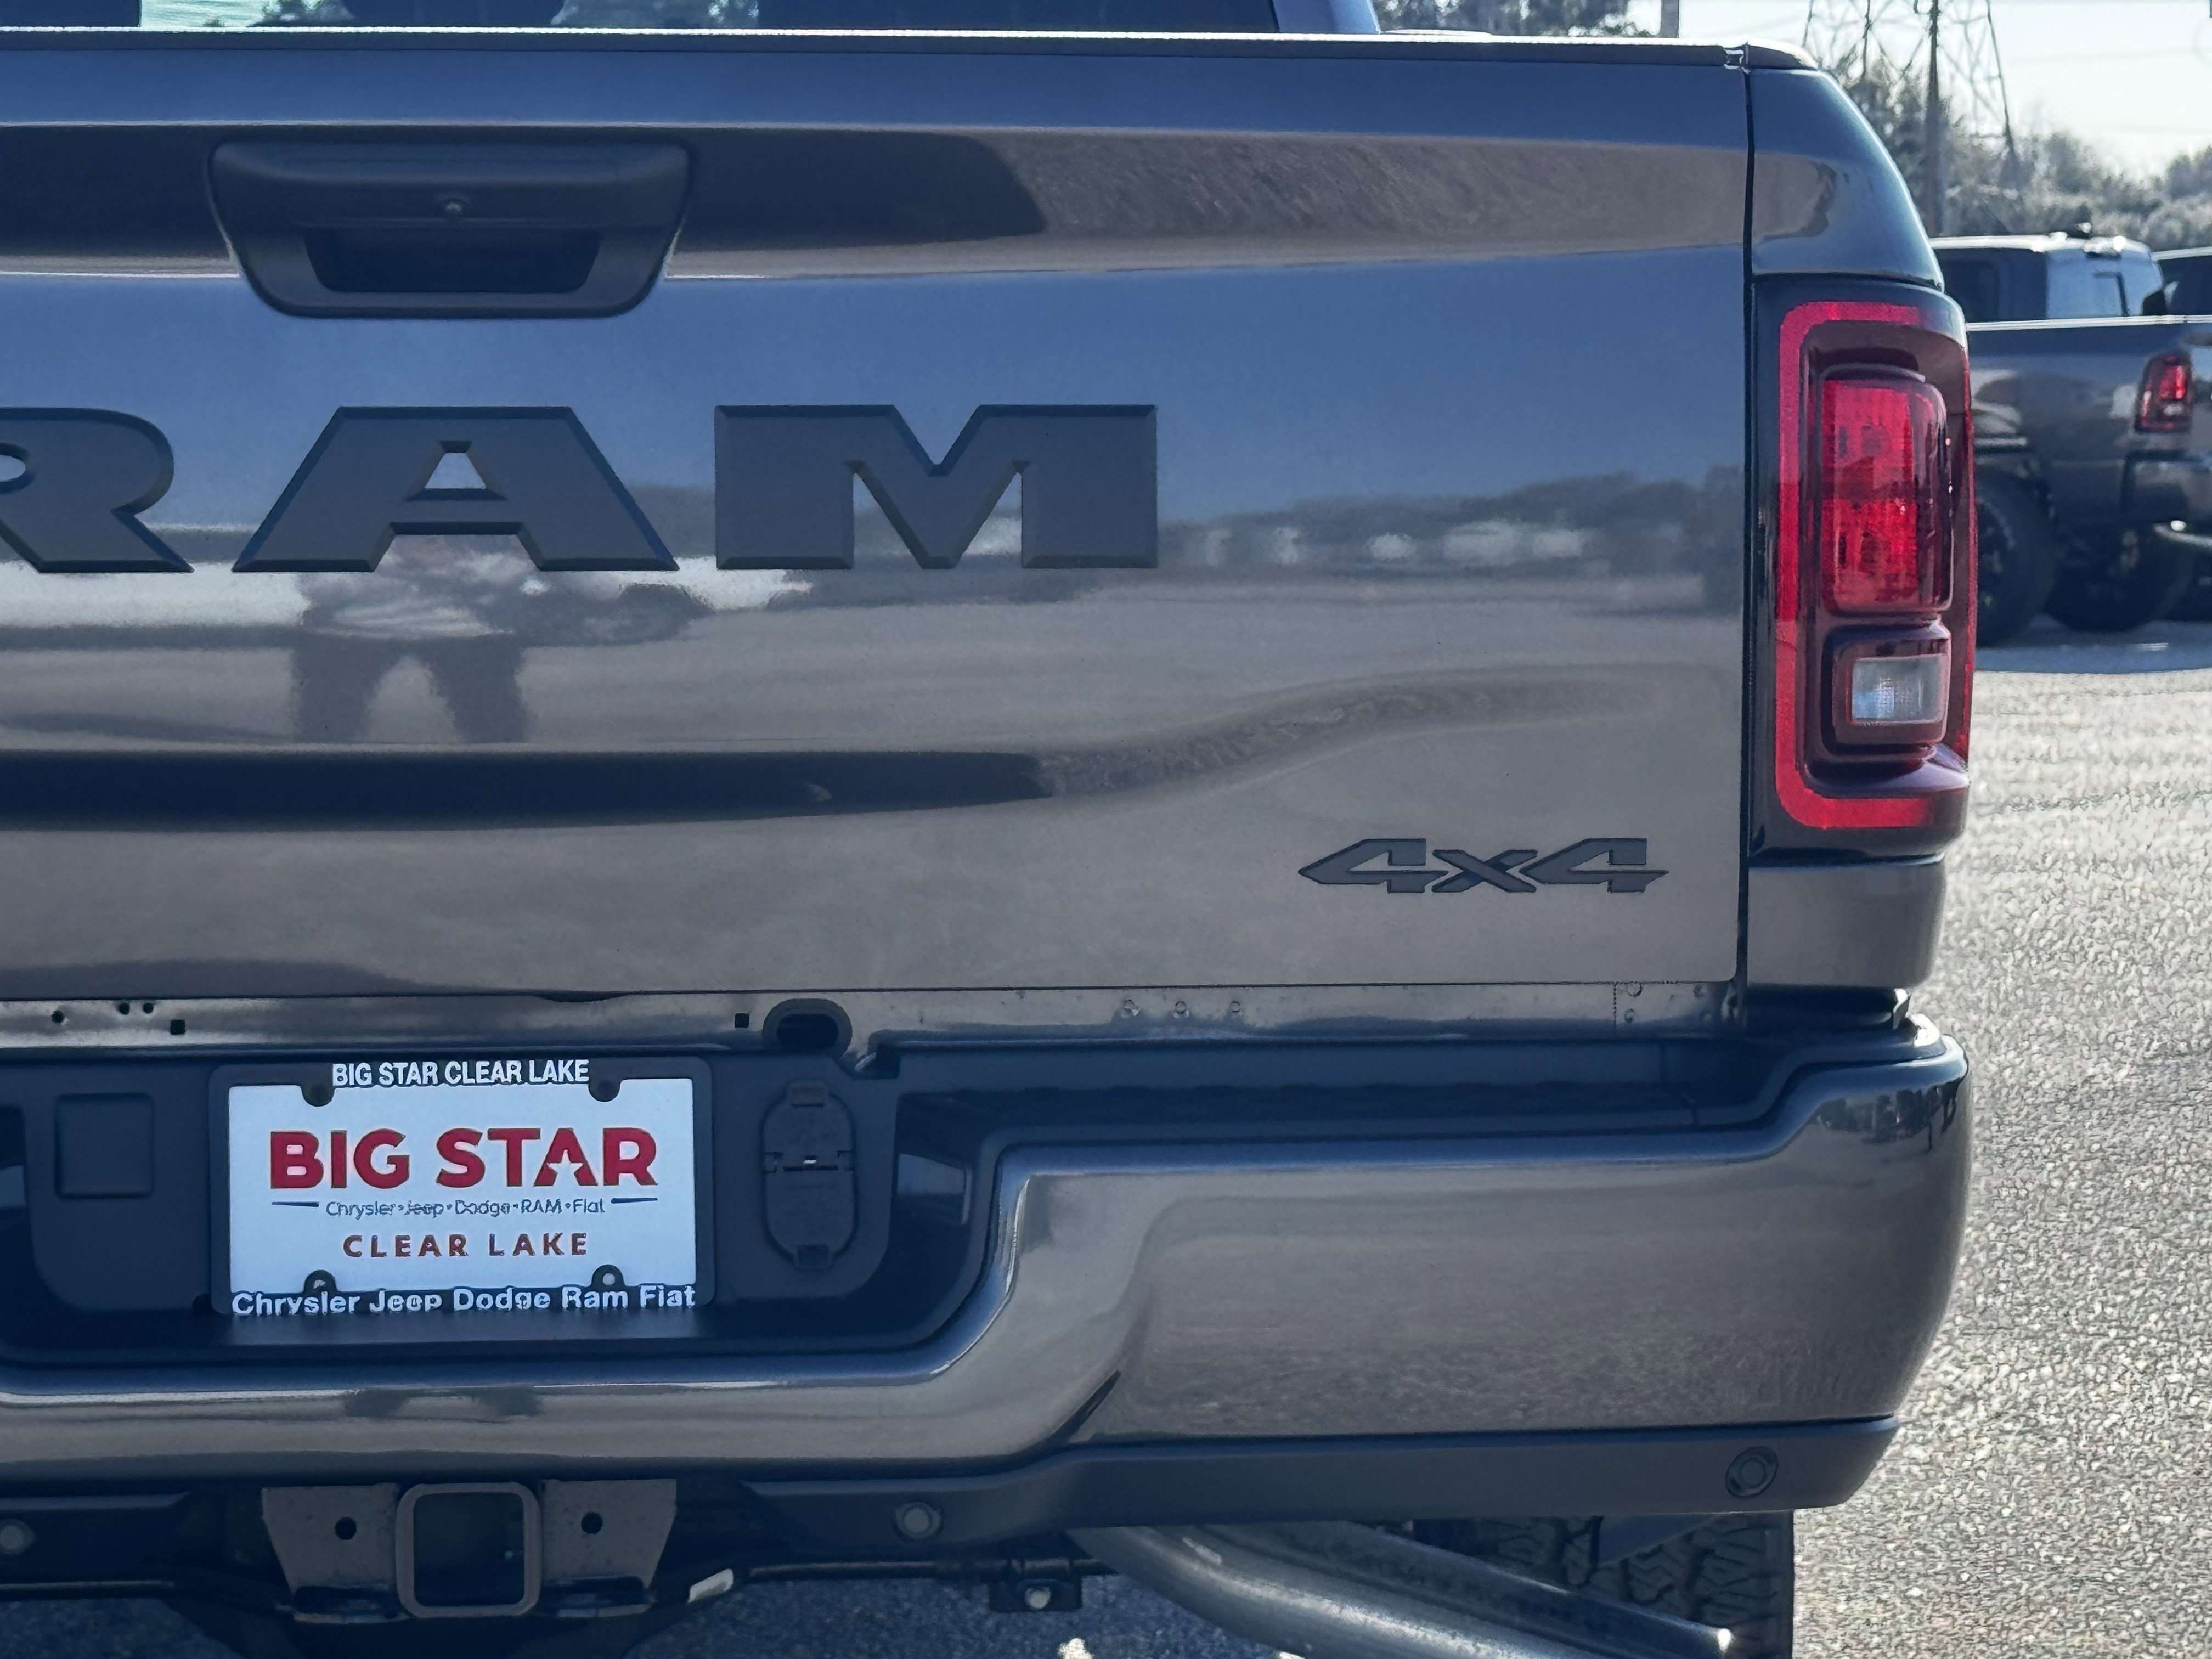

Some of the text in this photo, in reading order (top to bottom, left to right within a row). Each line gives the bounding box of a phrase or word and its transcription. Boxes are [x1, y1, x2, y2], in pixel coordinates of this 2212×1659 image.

[1298, 838, 1669, 894] 4x4
[332, 1059, 590, 1086] BIG STAR CLEAR LAKE
[270, 1127, 659, 1189] BIG STAR
[342, 1232, 587, 1257] CLEAR LAKE
[232, 1285, 696, 1315] Chrysler Jeep Dodge Ram Fiat
